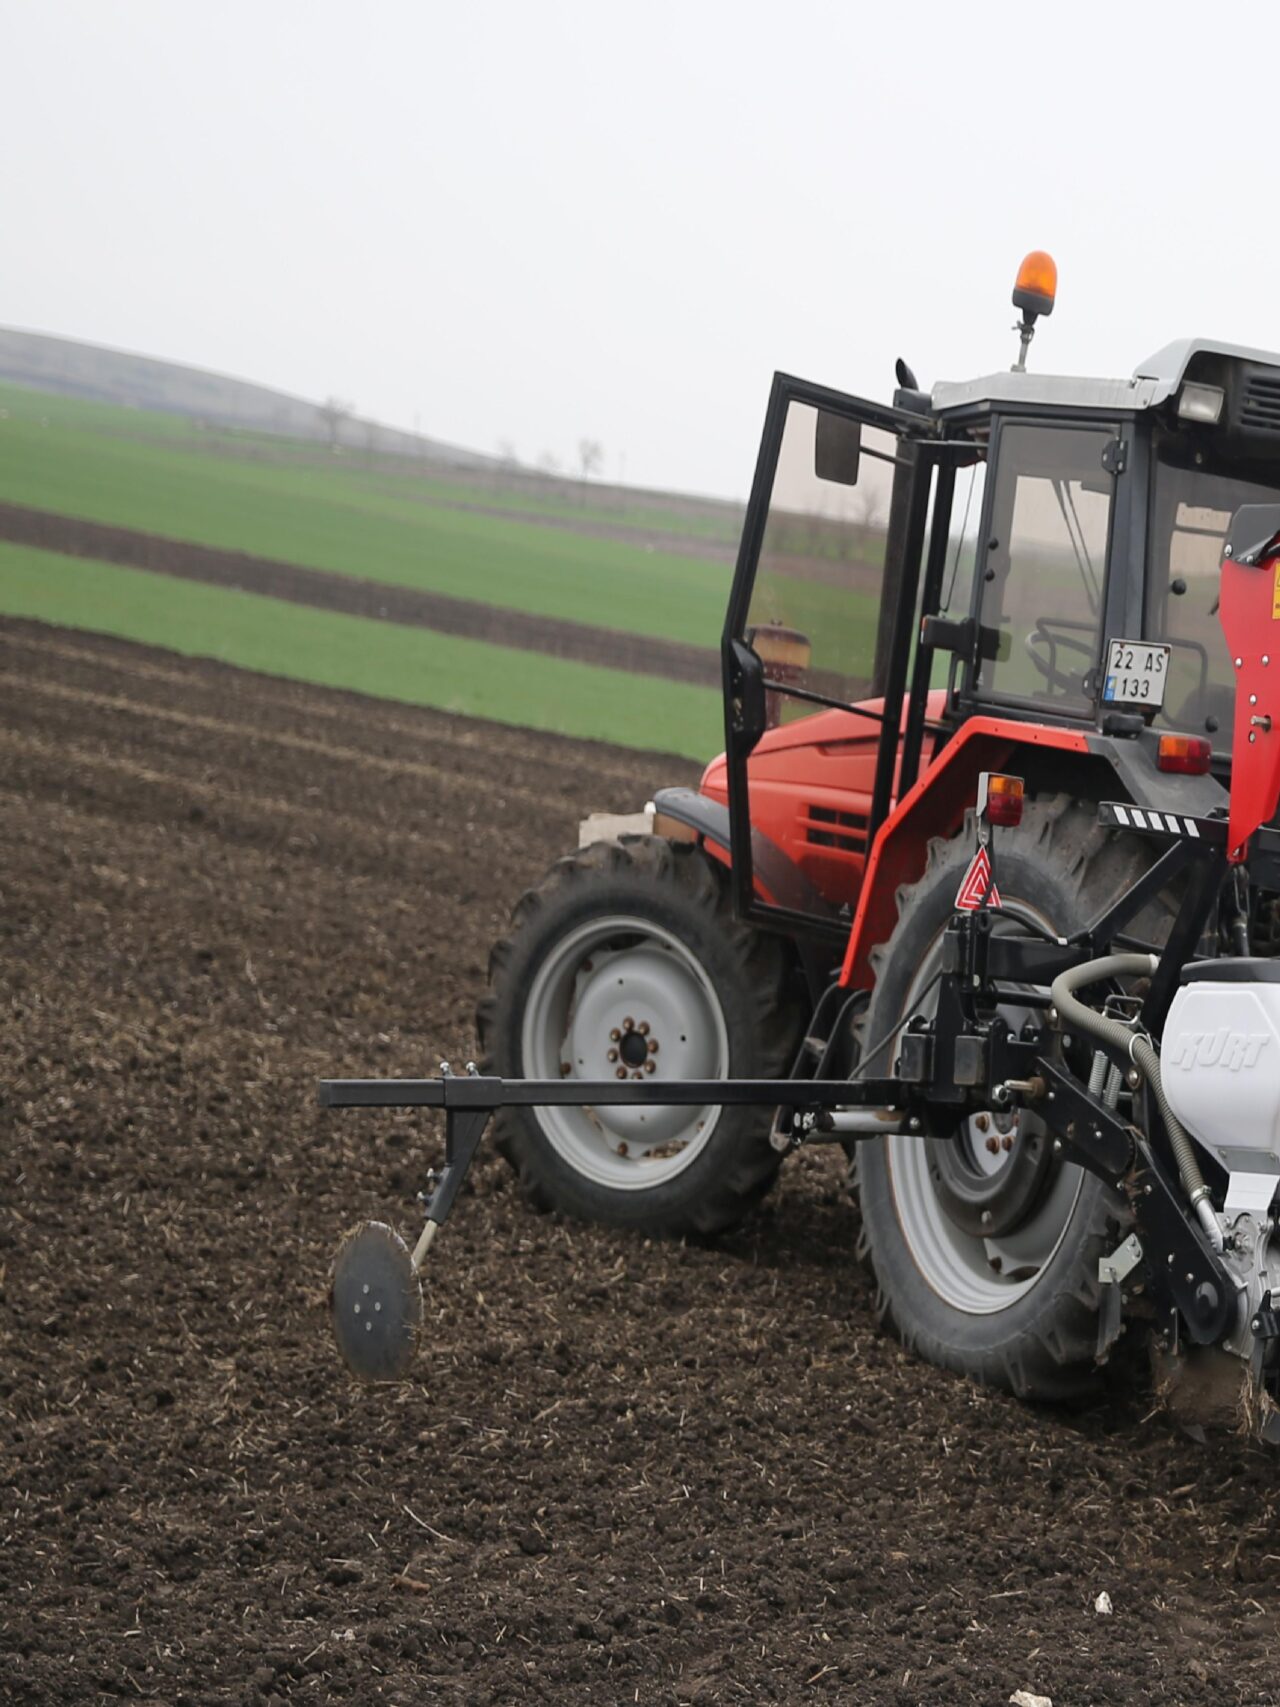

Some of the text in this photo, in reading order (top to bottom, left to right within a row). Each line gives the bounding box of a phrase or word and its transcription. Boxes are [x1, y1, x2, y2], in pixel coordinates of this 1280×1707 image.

[1114, 650, 1164, 672] 22 AS
[1122, 678, 1150, 698] 133
[1170, 1028, 1271, 1071] KURT
